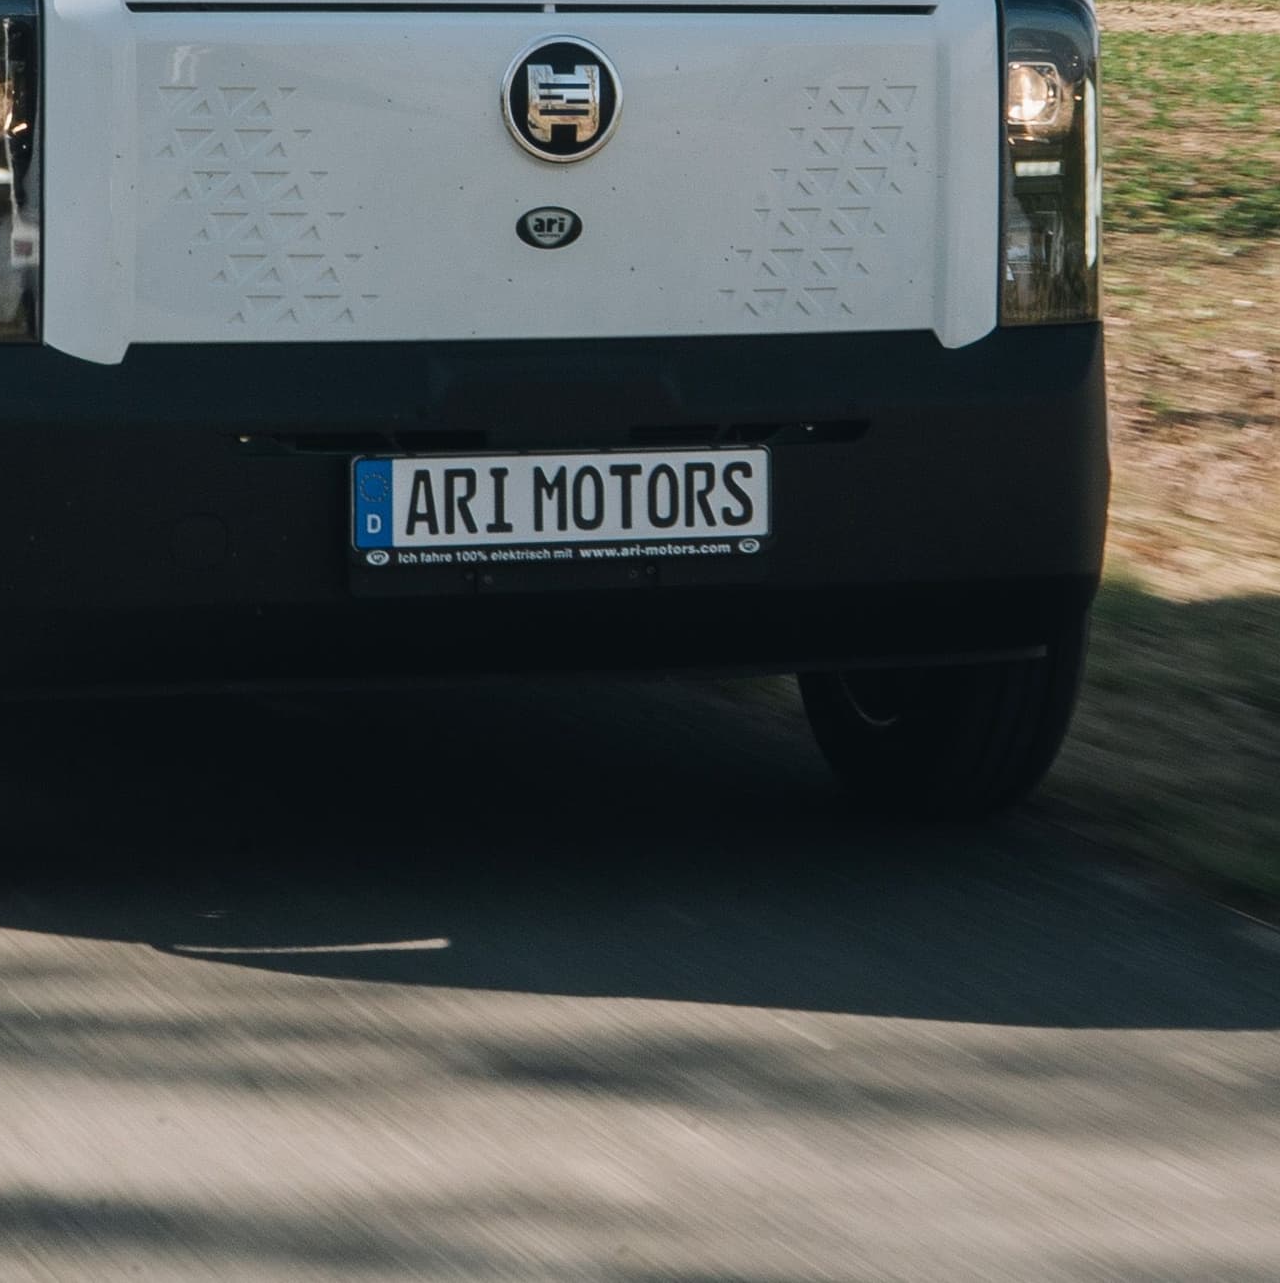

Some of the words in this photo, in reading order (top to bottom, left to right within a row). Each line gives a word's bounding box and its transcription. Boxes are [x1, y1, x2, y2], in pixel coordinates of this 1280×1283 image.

[533, 216, 565, 233] ari
[366, 514, 382, 534] D
[405, 467, 514, 535] ARI
[533, 461, 755, 532] MOTORS
[397, 552, 418, 564] Ich
[420, 550, 452, 564] fahre
[456, 550, 488, 562] 100%
[490, 548, 552, 562] elektrisch
[553, 547, 573, 560] mit
[578, 542, 732, 559] www.ari-motors.com
